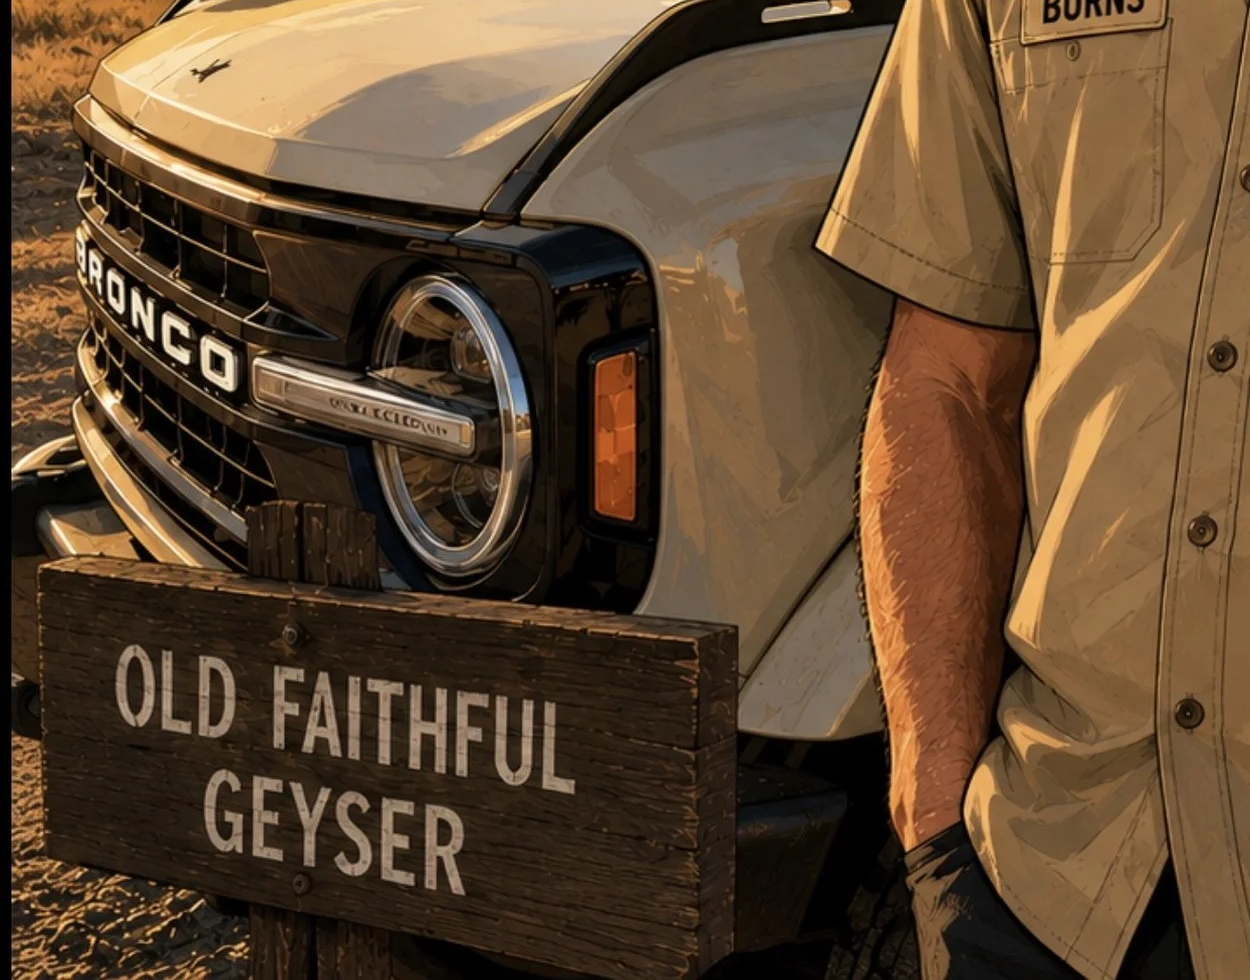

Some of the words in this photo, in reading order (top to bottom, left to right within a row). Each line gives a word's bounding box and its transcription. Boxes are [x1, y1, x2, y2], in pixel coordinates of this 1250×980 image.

[76, 226, 237, 393] BRONCO
[115, 644, 236, 738] OLD
[273, 666, 576, 794] FAITHFUL
[204, 769, 467, 896] GEYSER
